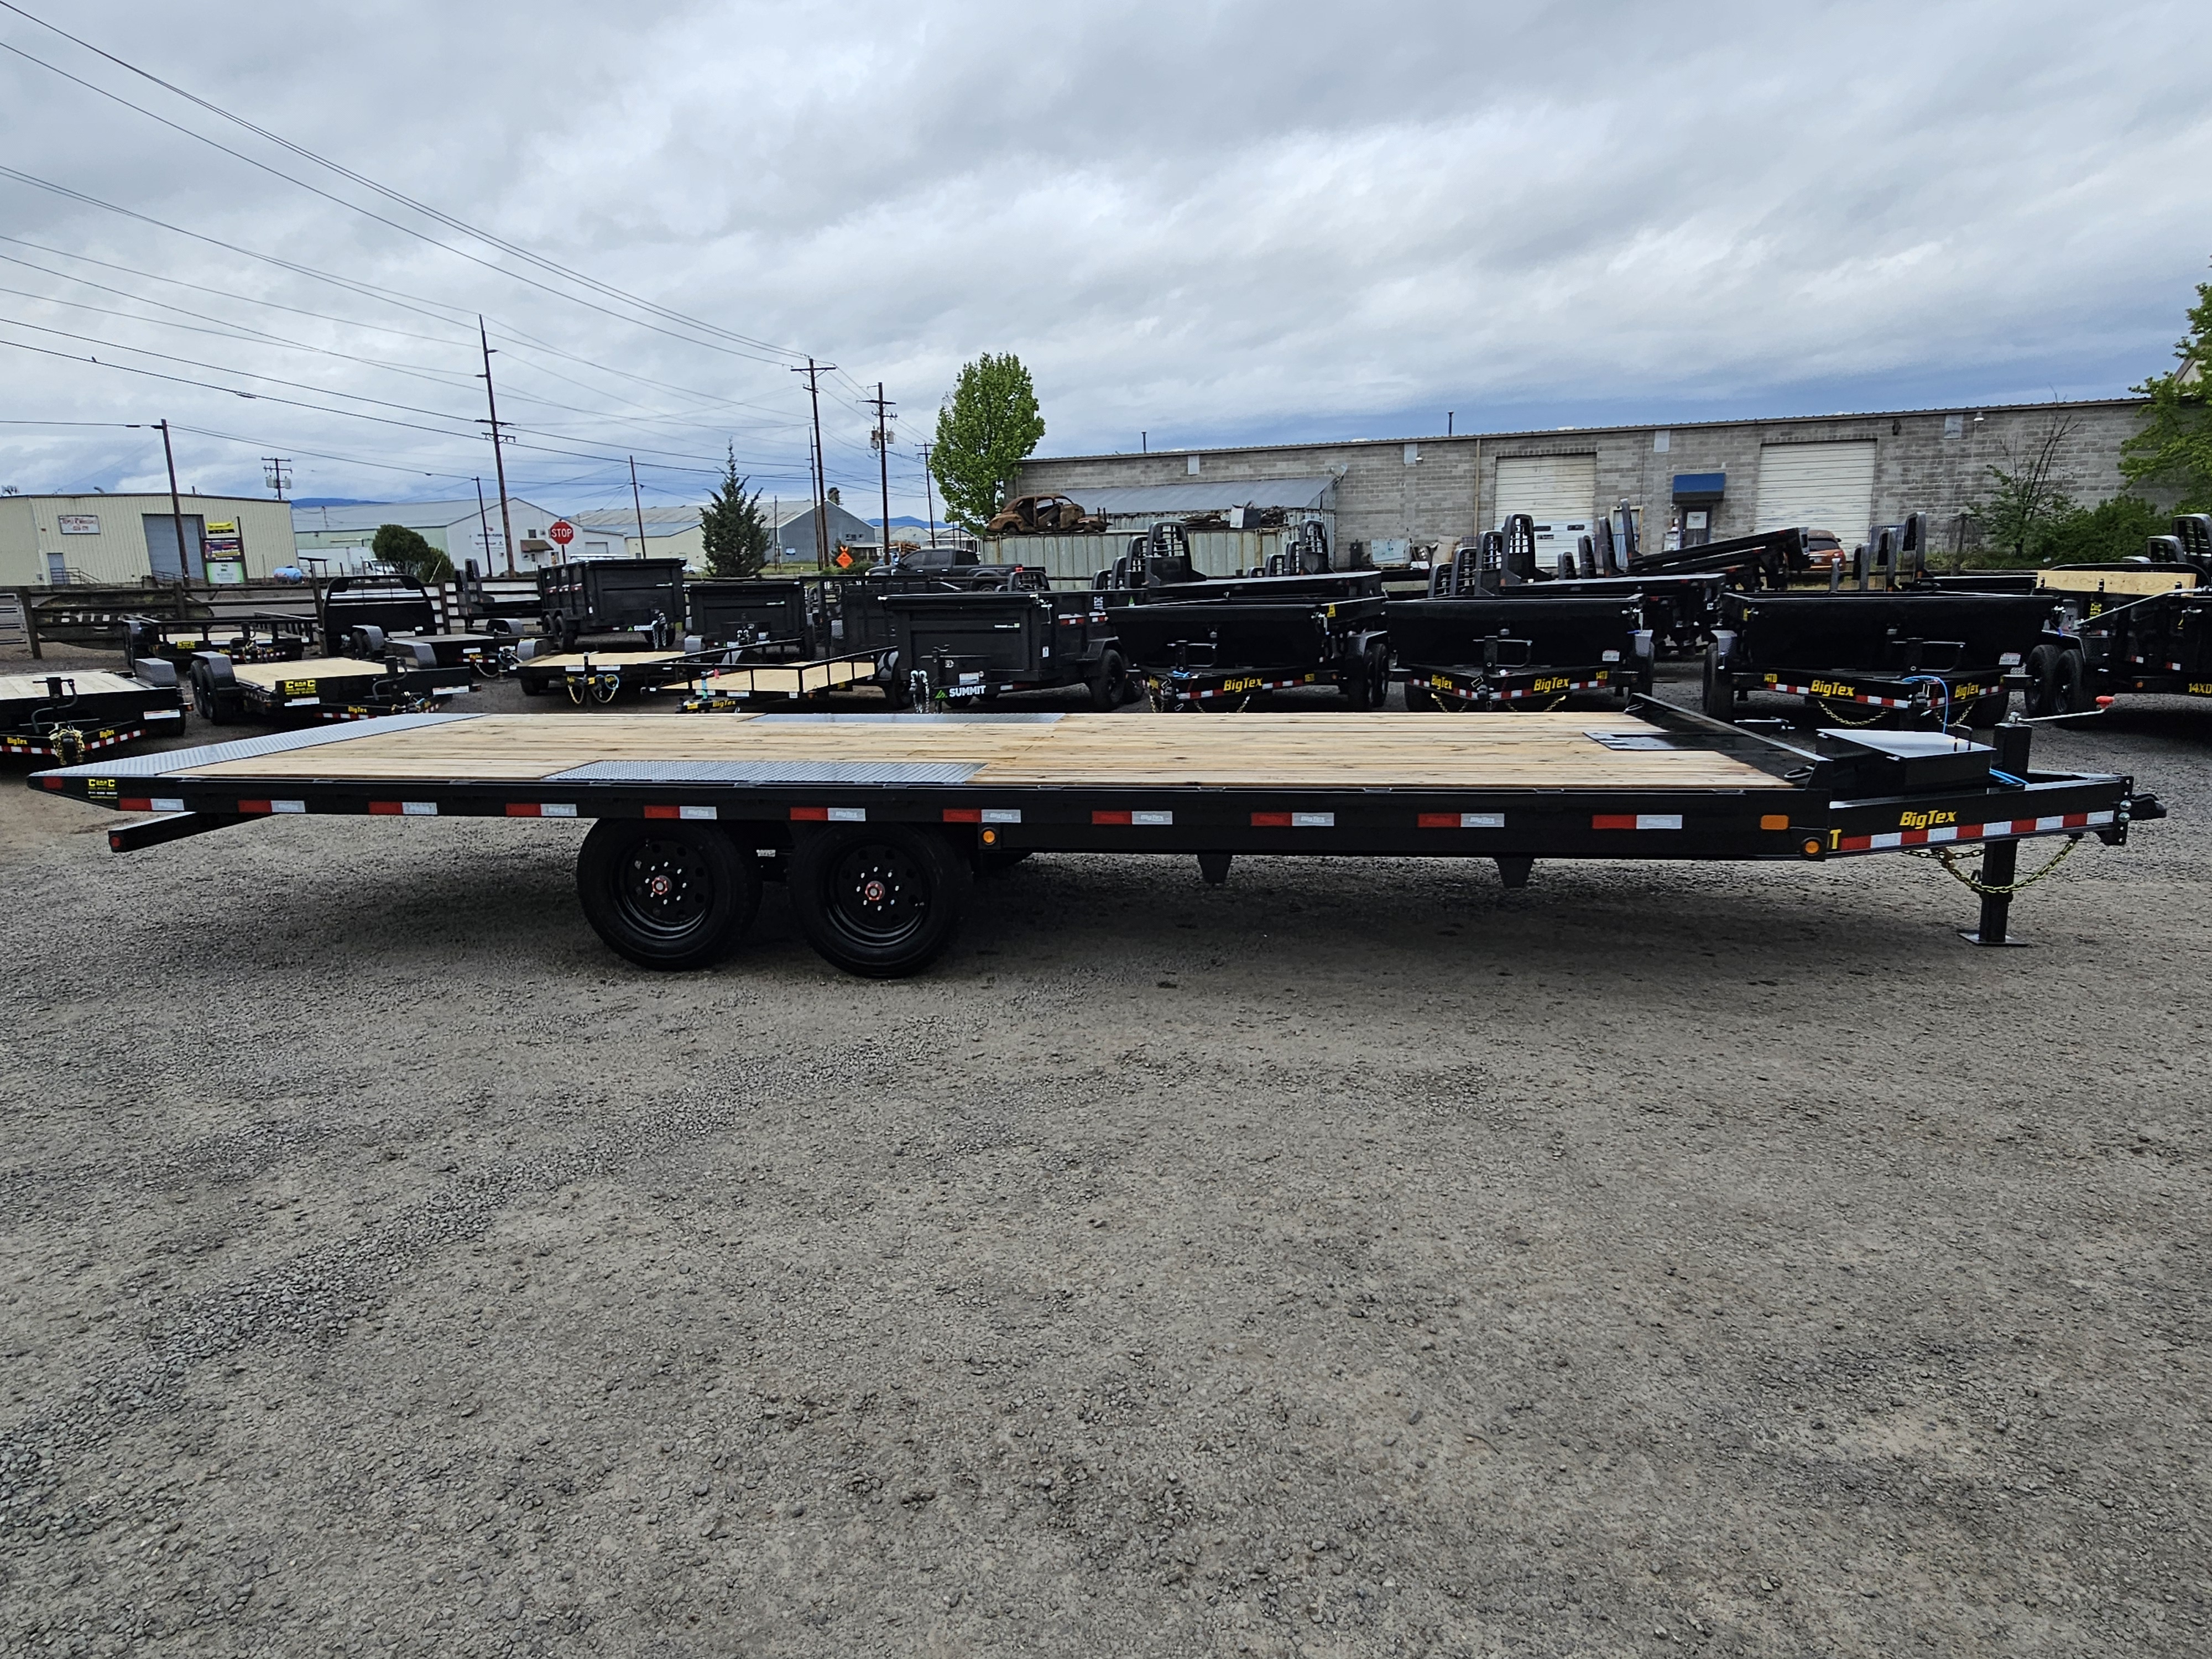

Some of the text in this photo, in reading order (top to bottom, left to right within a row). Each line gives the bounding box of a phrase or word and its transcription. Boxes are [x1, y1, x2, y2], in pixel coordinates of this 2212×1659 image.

[551, 528, 572, 538] STOP
[1223, 677, 1263, 693] BigTex
[1431, 674, 1452, 690] BigTex
[1533, 677, 1570, 693] BigTex
[1810, 680, 1855, 697] BigTex
[949, 685, 986, 697] SUMMIT
[1954, 682, 1979, 699] BigTex
[712, 700, 736, 708] BigTex
[7, 737, 28, 745] BigTex
[1899, 810, 1957, 830] BigTex
[1830, 829, 1841, 849] T
